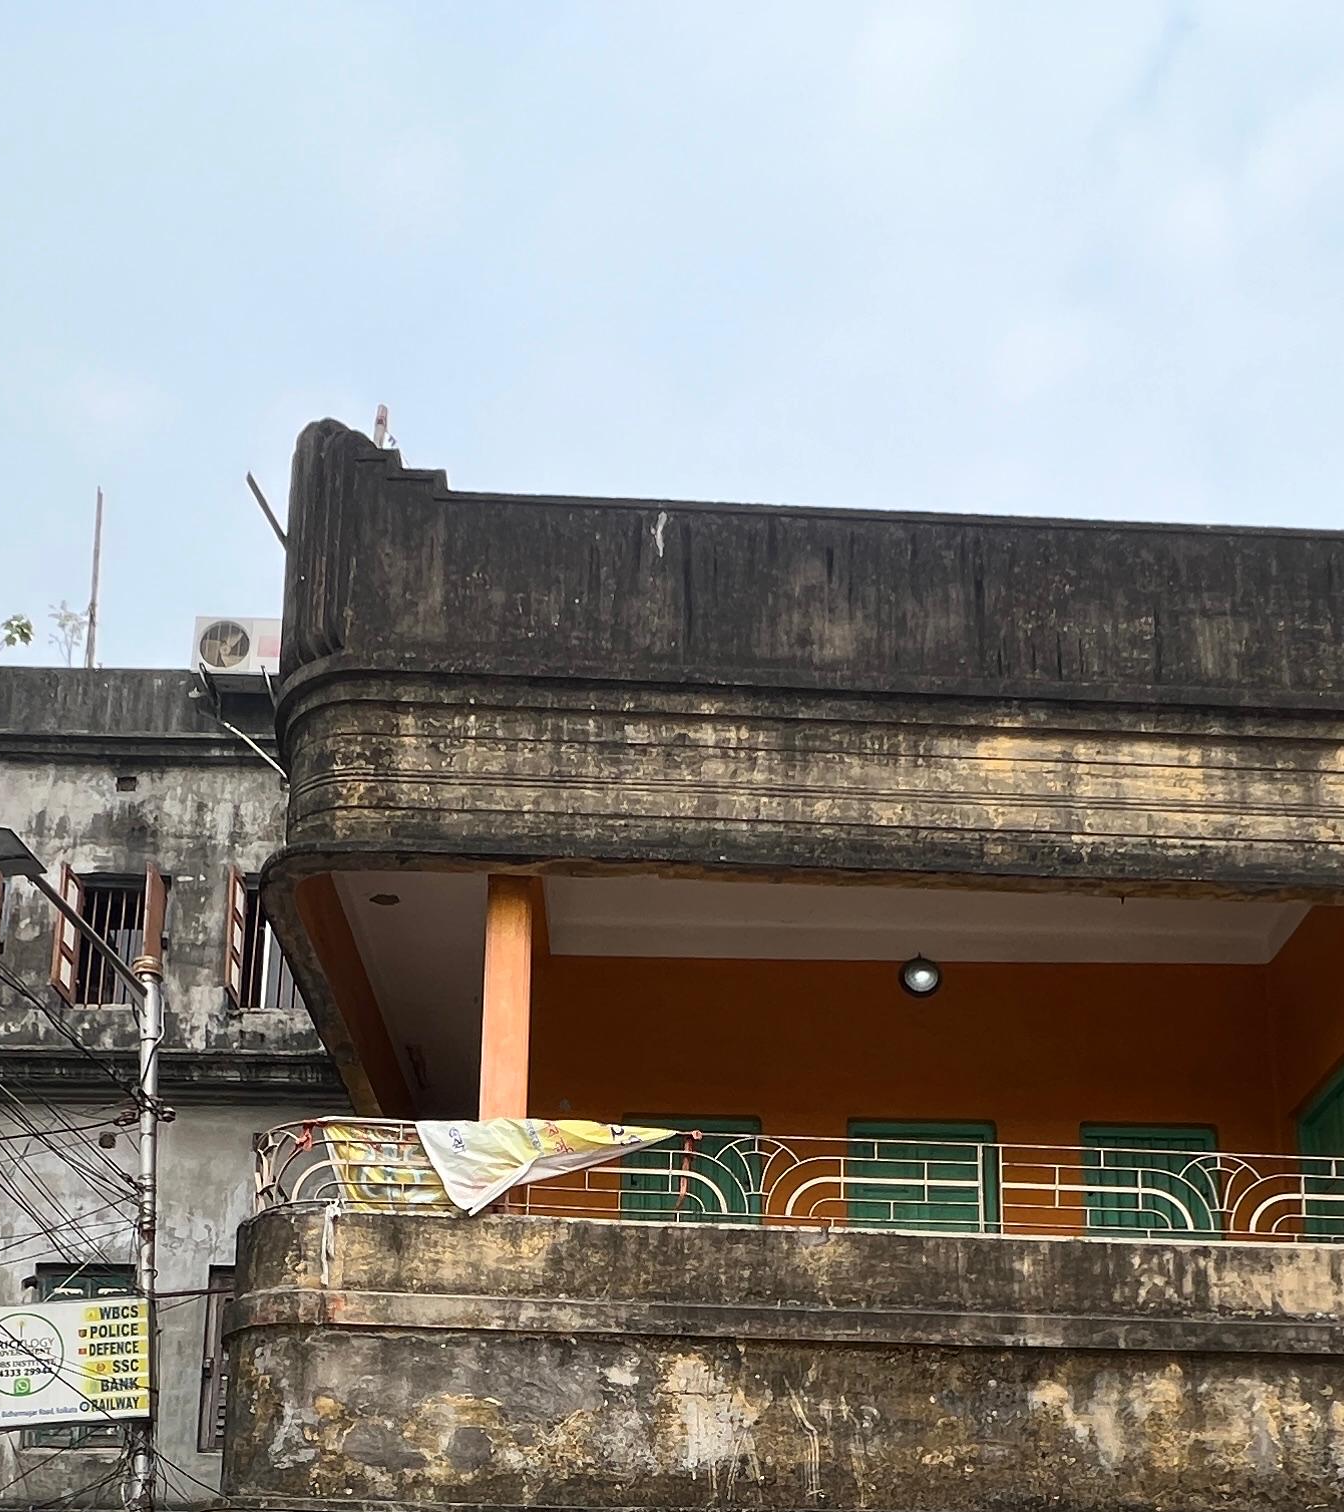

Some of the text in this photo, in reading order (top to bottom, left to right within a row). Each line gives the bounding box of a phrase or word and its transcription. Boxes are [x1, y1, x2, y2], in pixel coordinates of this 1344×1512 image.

[99, 1305, 139, 1320] WBCS
[90, 1323, 139, 1338] POLICE
[89, 1341, 139, 1356] DEFENCE
[112, 1358, 139, 1373] SSC
[101, 1376, 139, 1392] BANK
[91, 1396, 140, 1412] RAILWAY
